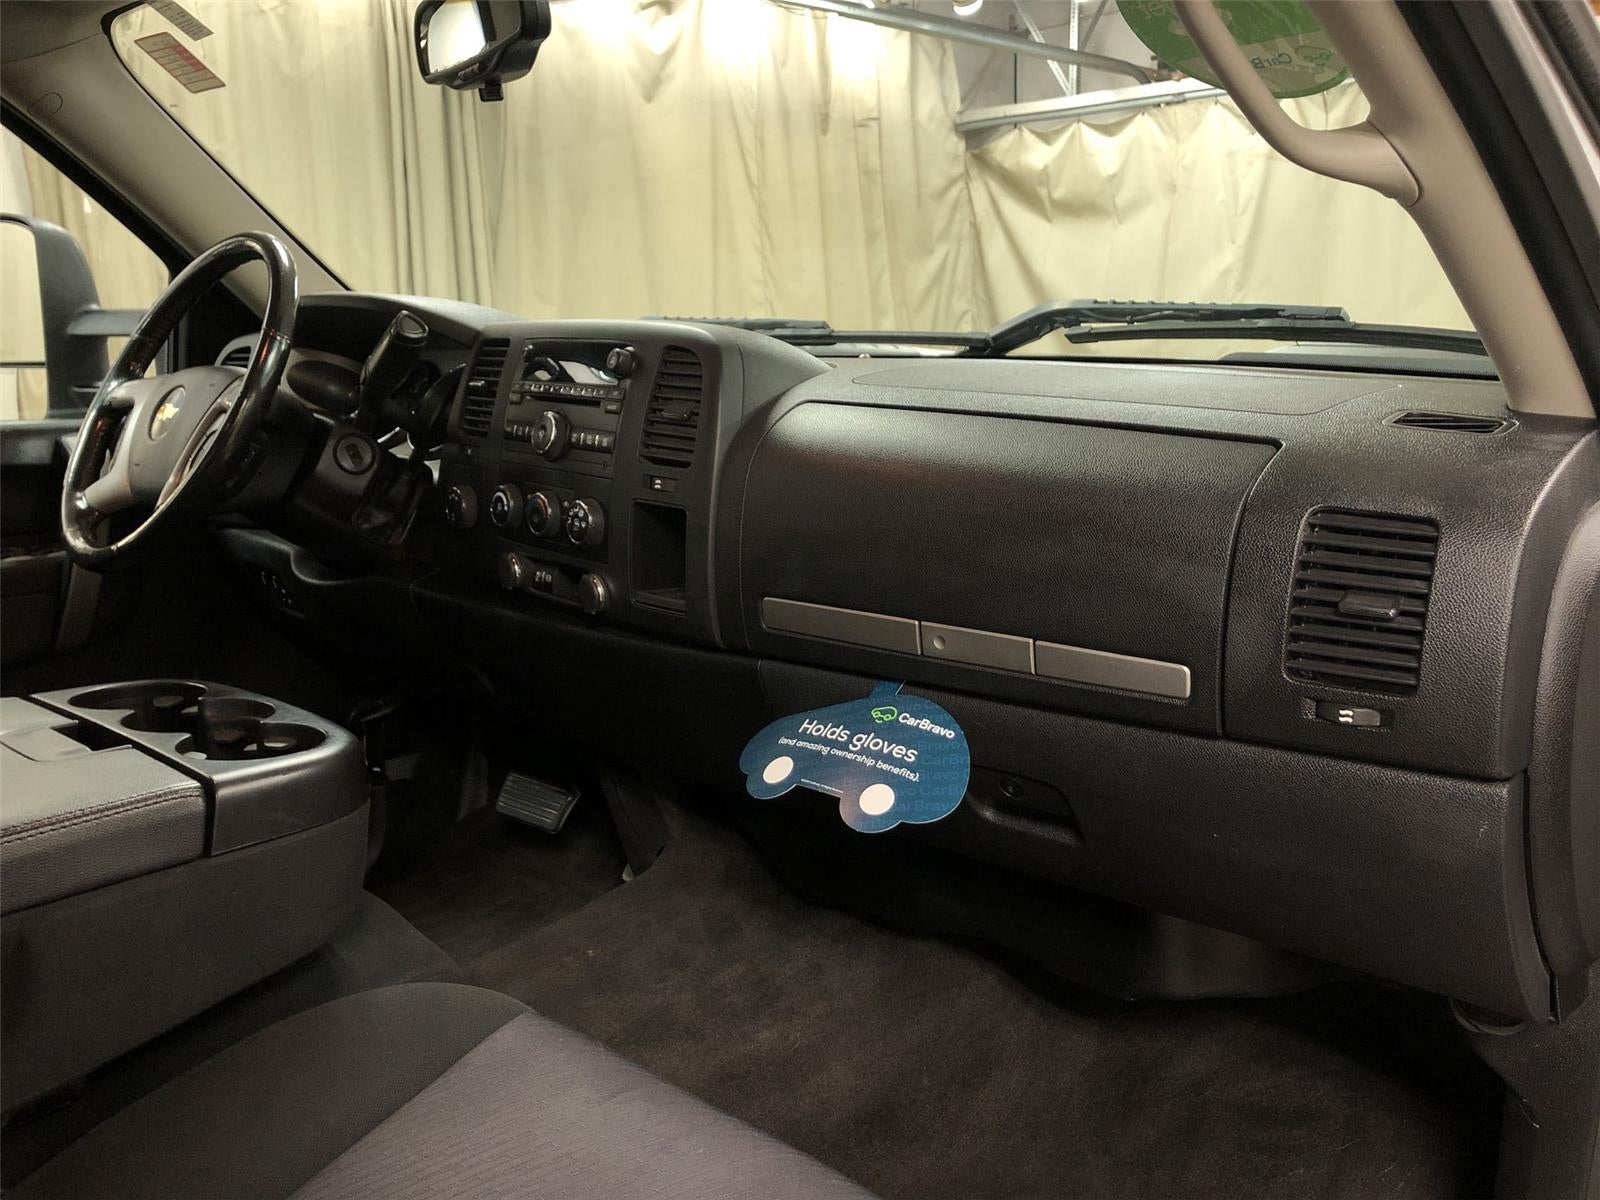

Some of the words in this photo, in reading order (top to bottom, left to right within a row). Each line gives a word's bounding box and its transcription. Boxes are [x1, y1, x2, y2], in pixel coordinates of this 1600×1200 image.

[798, 719, 850, 742] Holds
[849, 733, 918, 762] gloves
[899, 713, 955, 738] CarBravo
[778, 736, 797, 746] (and
[796, 739, 830, 755] amazing
[830, 748, 876, 766] ownership
[876, 760, 919, 782] benefits).
